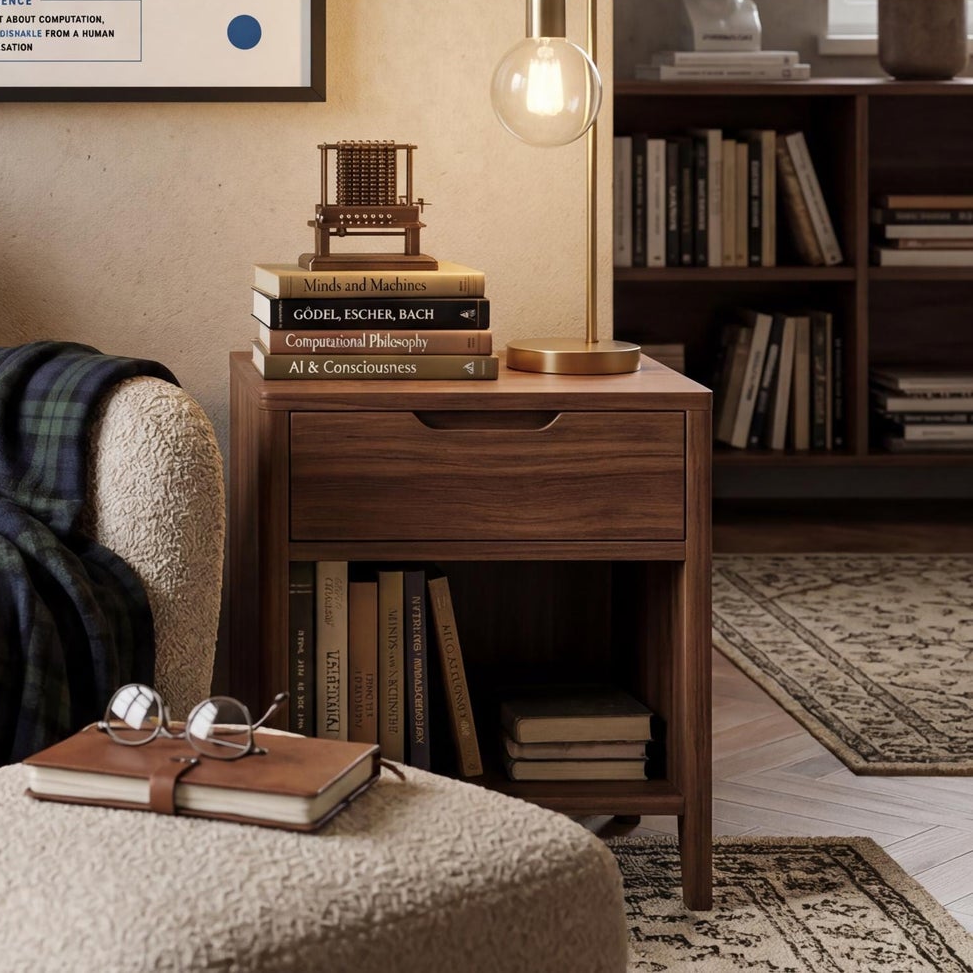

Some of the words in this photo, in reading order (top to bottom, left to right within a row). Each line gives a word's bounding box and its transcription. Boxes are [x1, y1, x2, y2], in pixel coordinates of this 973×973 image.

[5, 15, 36, 24] ABOUT
[38, 15, 105, 25] COMPUTATION,
[45, 29, 70, 38] FROM
[72, 29, 79, 38] A
[82, 29, 115, 38] HUMAN
[303, 277, 342, 292] Minds
[345, 277, 367, 292] and
[344, 308, 396, 322] ESCHER,
[399, 308, 434, 320] BACH
[285, 332, 366, 352] Computational
[288, 360, 304, 374] AI
[307, 360, 319, 374] &
[323, 359, 417, 374] Consciousness
